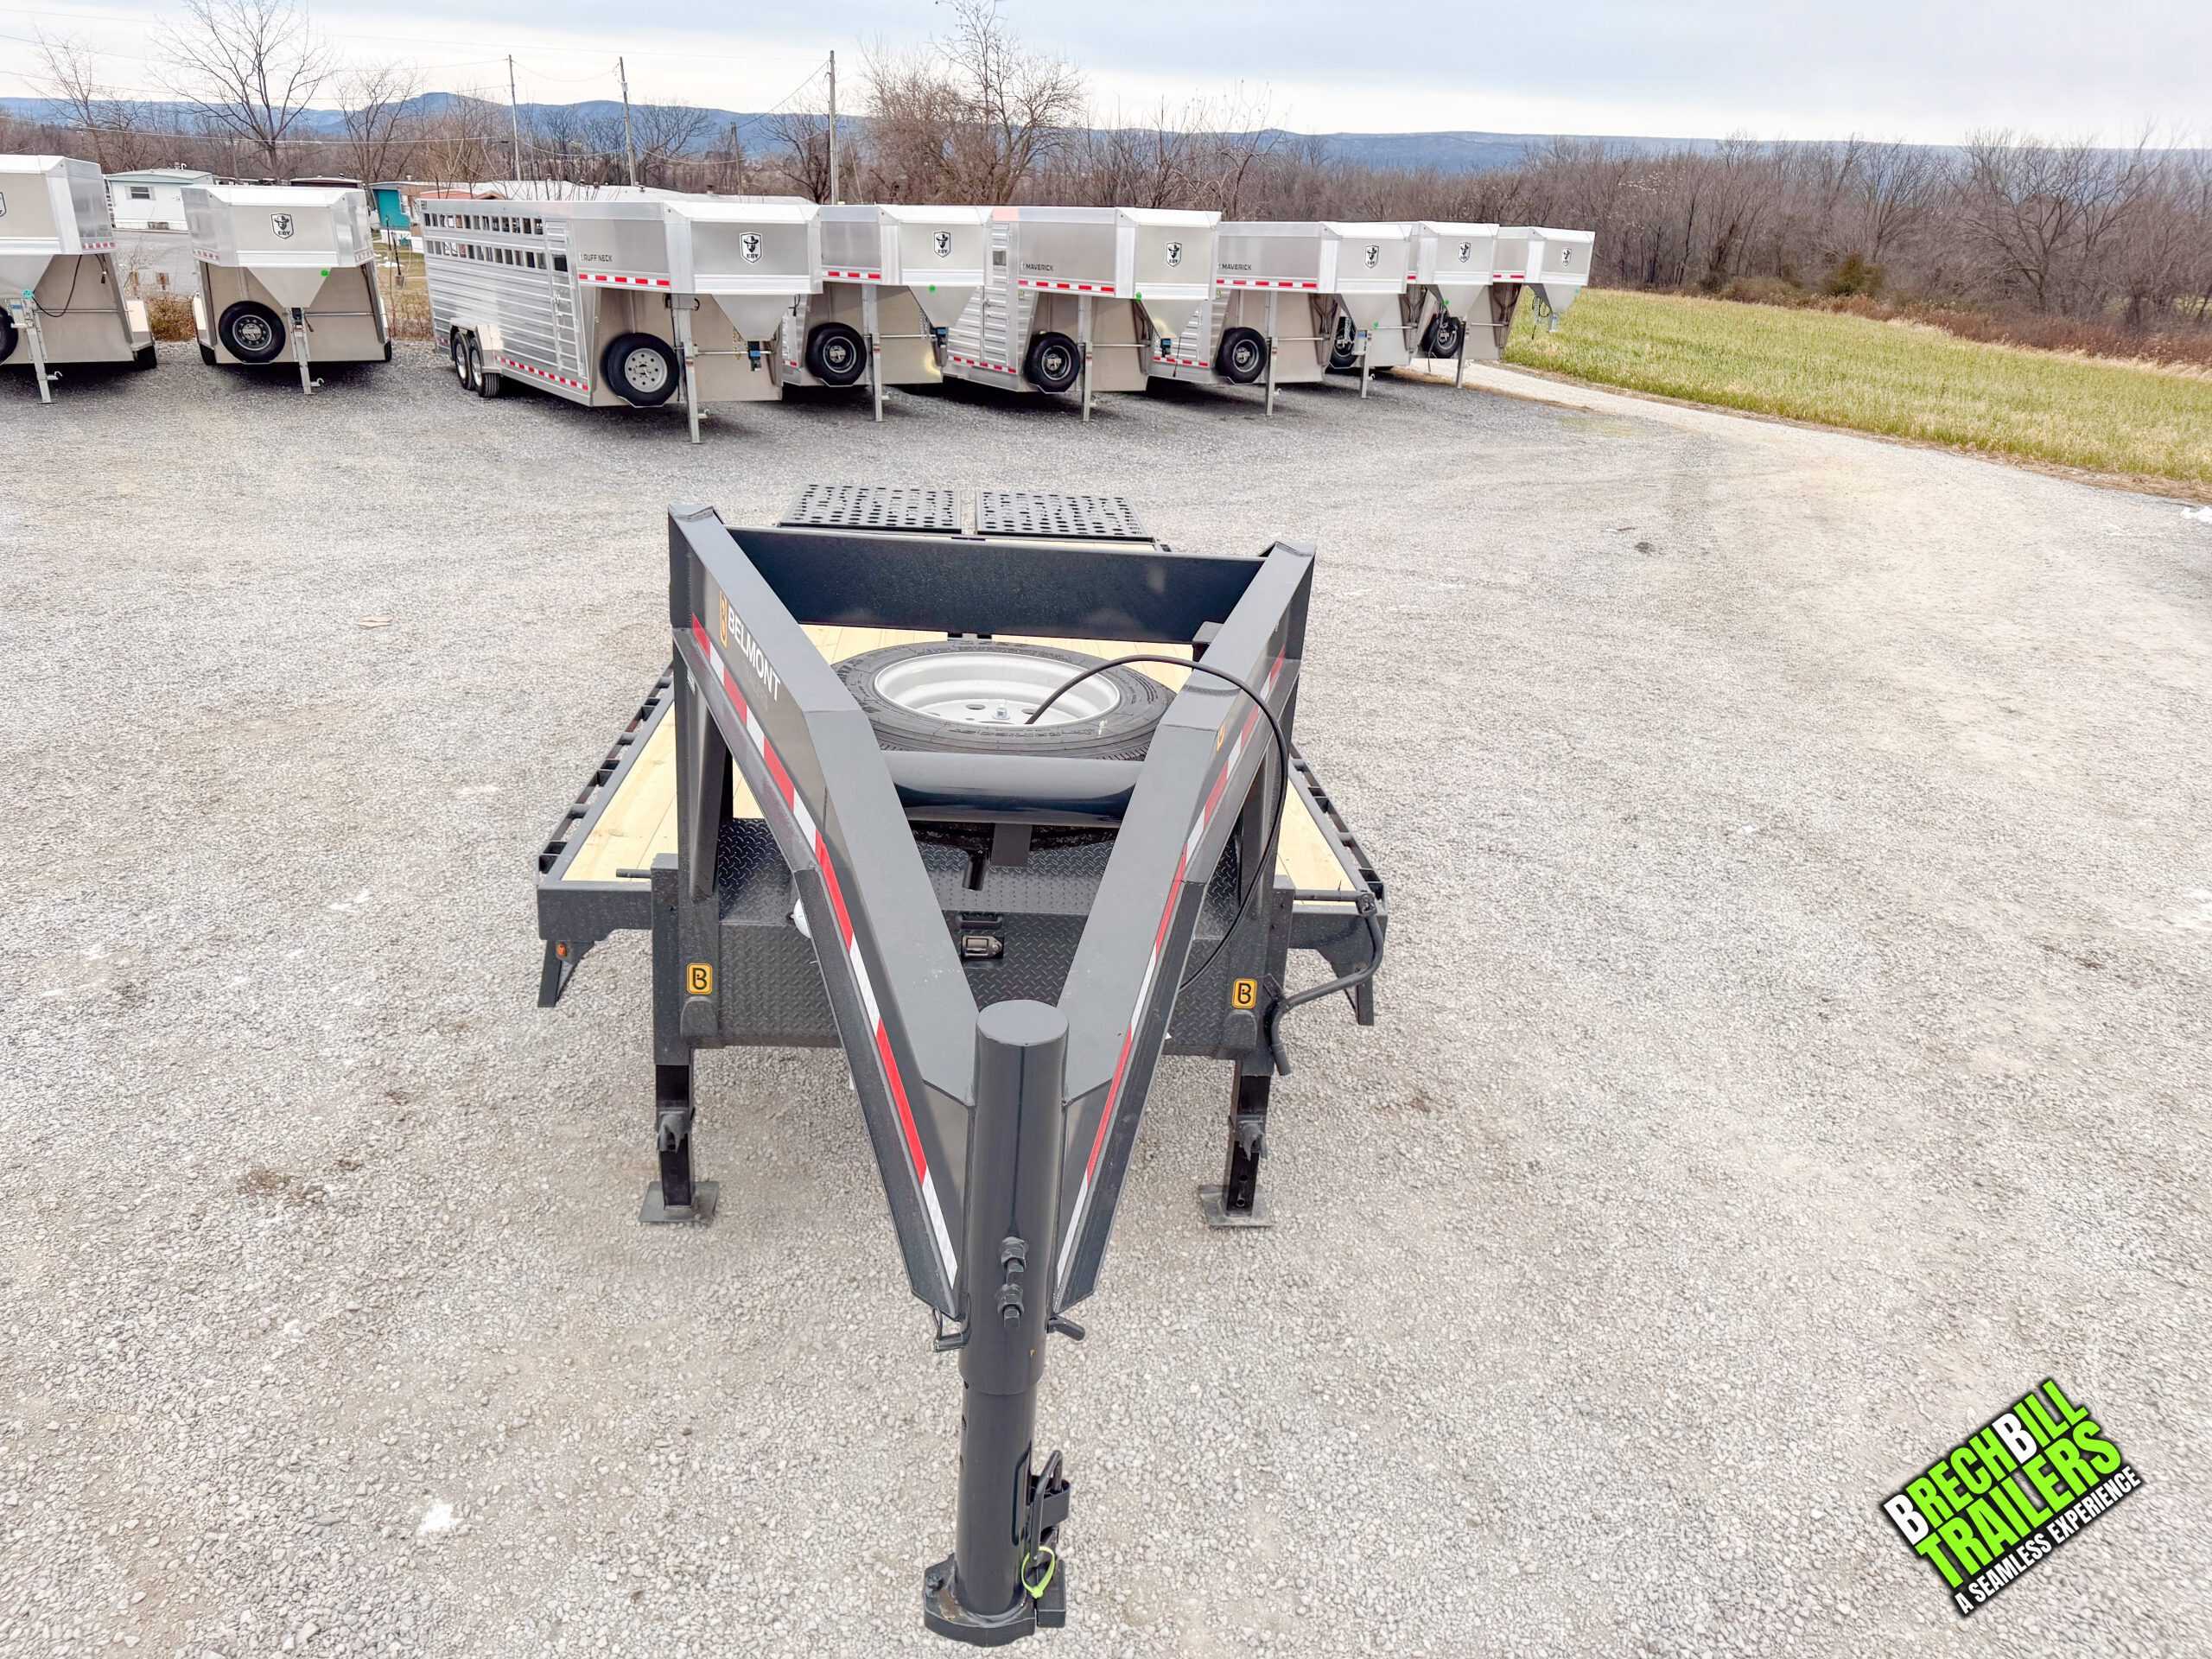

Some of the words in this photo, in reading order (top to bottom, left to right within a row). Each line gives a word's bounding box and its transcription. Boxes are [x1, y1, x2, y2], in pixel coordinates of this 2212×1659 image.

[728, 604, 780, 702] BELMONT
[692, 967, 707, 990] B
[1237, 982, 1251, 1005] B
